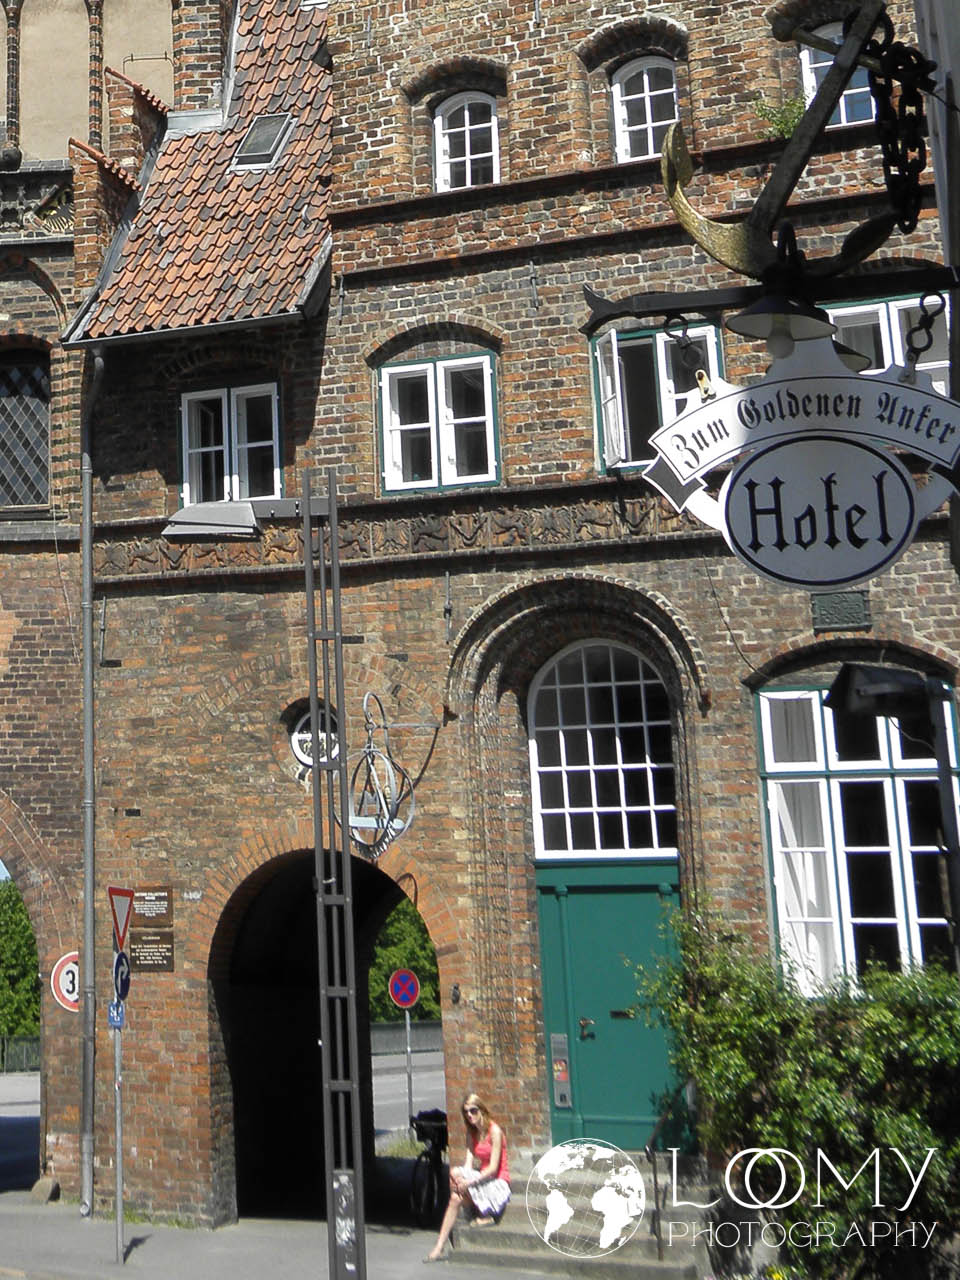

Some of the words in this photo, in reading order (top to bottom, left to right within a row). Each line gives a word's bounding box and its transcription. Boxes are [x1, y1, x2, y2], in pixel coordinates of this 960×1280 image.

[671, 417, 730, 470] Zum
[737, 391, 862, 430] Goldenen
[877, 392, 956, 445] Anker
[743, 469, 894, 554] Hotel
